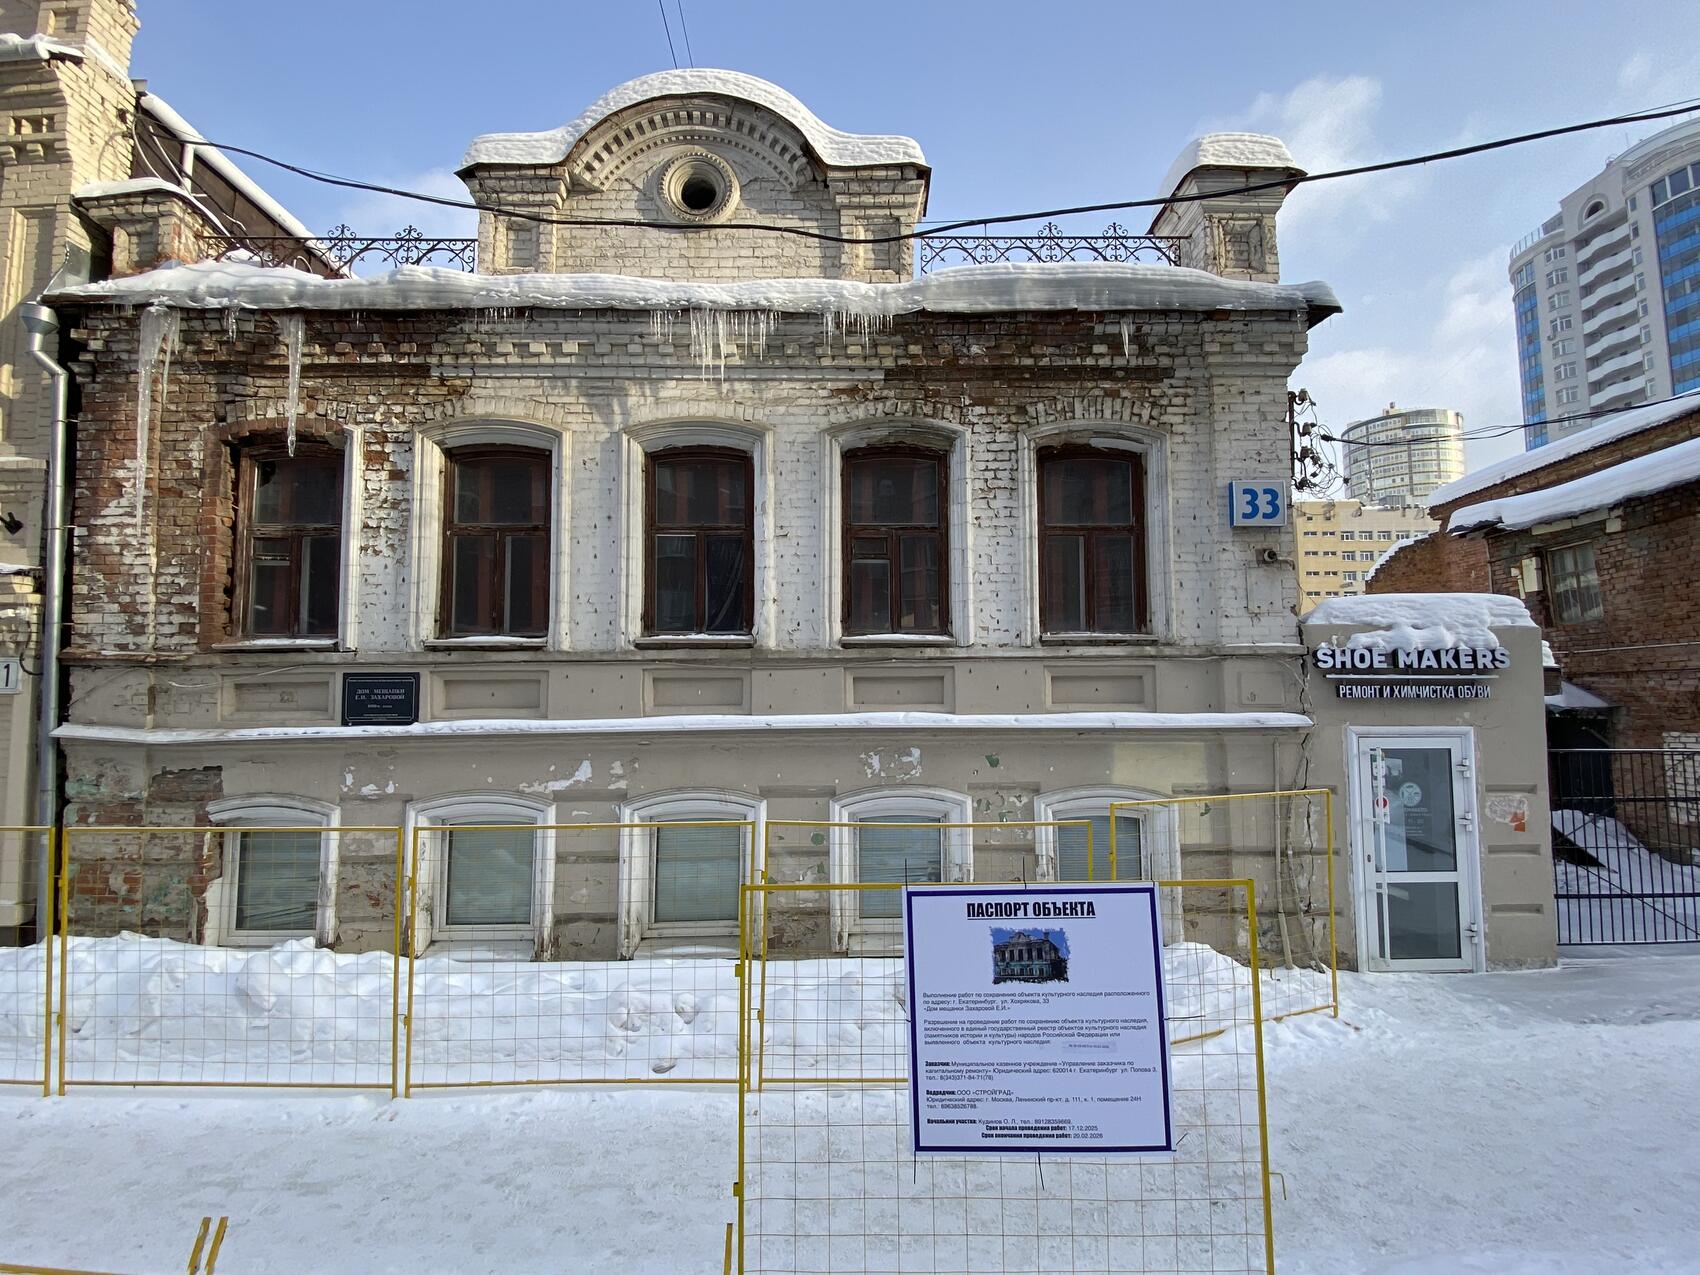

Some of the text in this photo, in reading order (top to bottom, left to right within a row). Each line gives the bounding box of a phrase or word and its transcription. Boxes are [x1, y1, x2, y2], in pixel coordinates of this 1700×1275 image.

[1242, 488, 1280, 520] 33
[1317, 647, 1511, 669] SHOE MAKERS
[1339, 686, 1491, 698] РЕМОНТ И ХИМЧИСТКА ОБУВИ
[966, 901, 1096, 917] ПАСПОРТ ОБЪЕКТА
